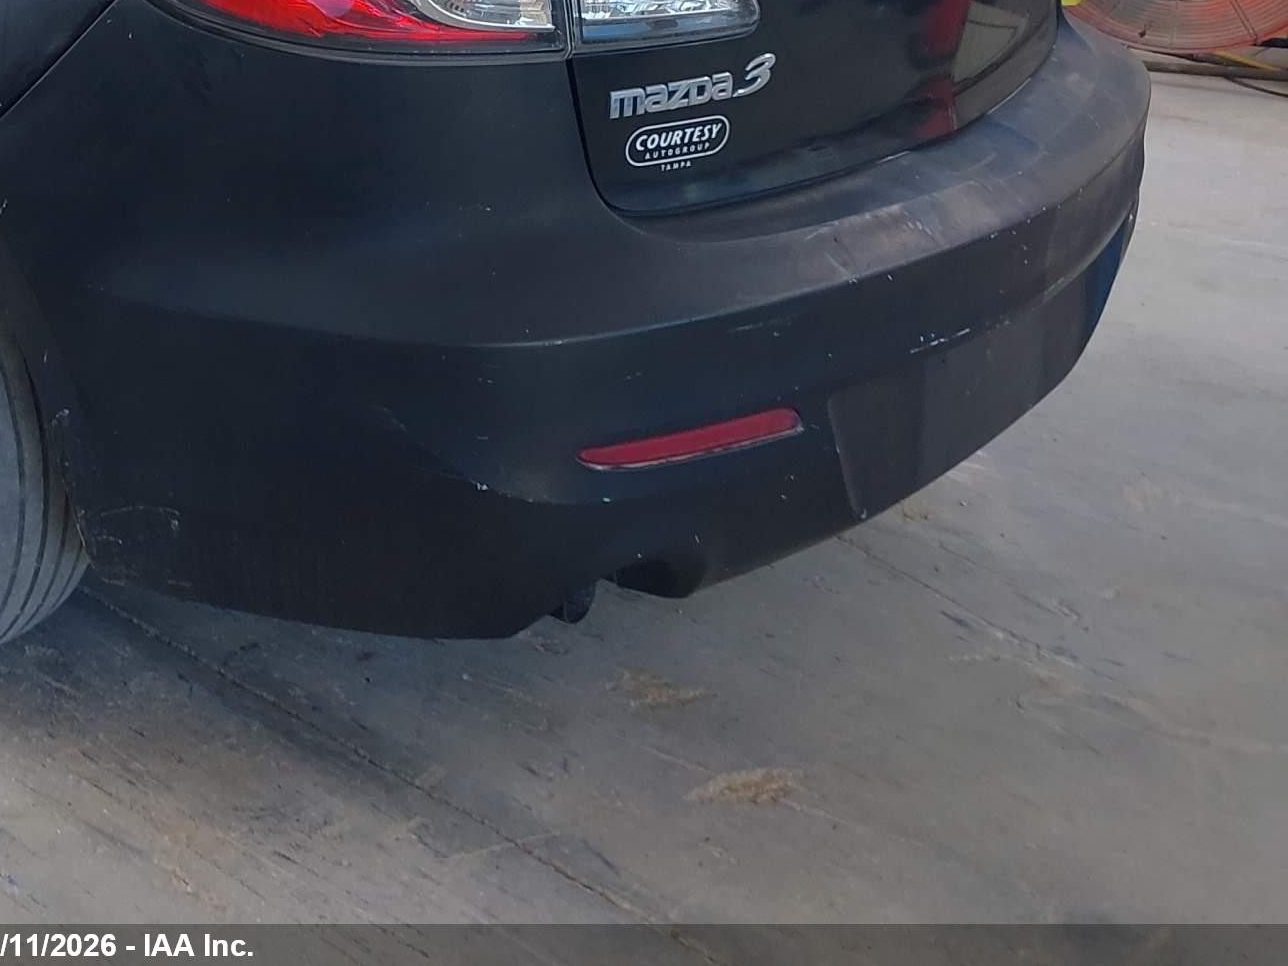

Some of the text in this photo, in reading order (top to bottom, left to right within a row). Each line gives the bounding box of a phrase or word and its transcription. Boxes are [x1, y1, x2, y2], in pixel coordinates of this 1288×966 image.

[635, 123, 723, 151] COURTESY
[644, 141, 711, 161] AUTOGROUP
[661, 160, 692, 172] TAMPA
